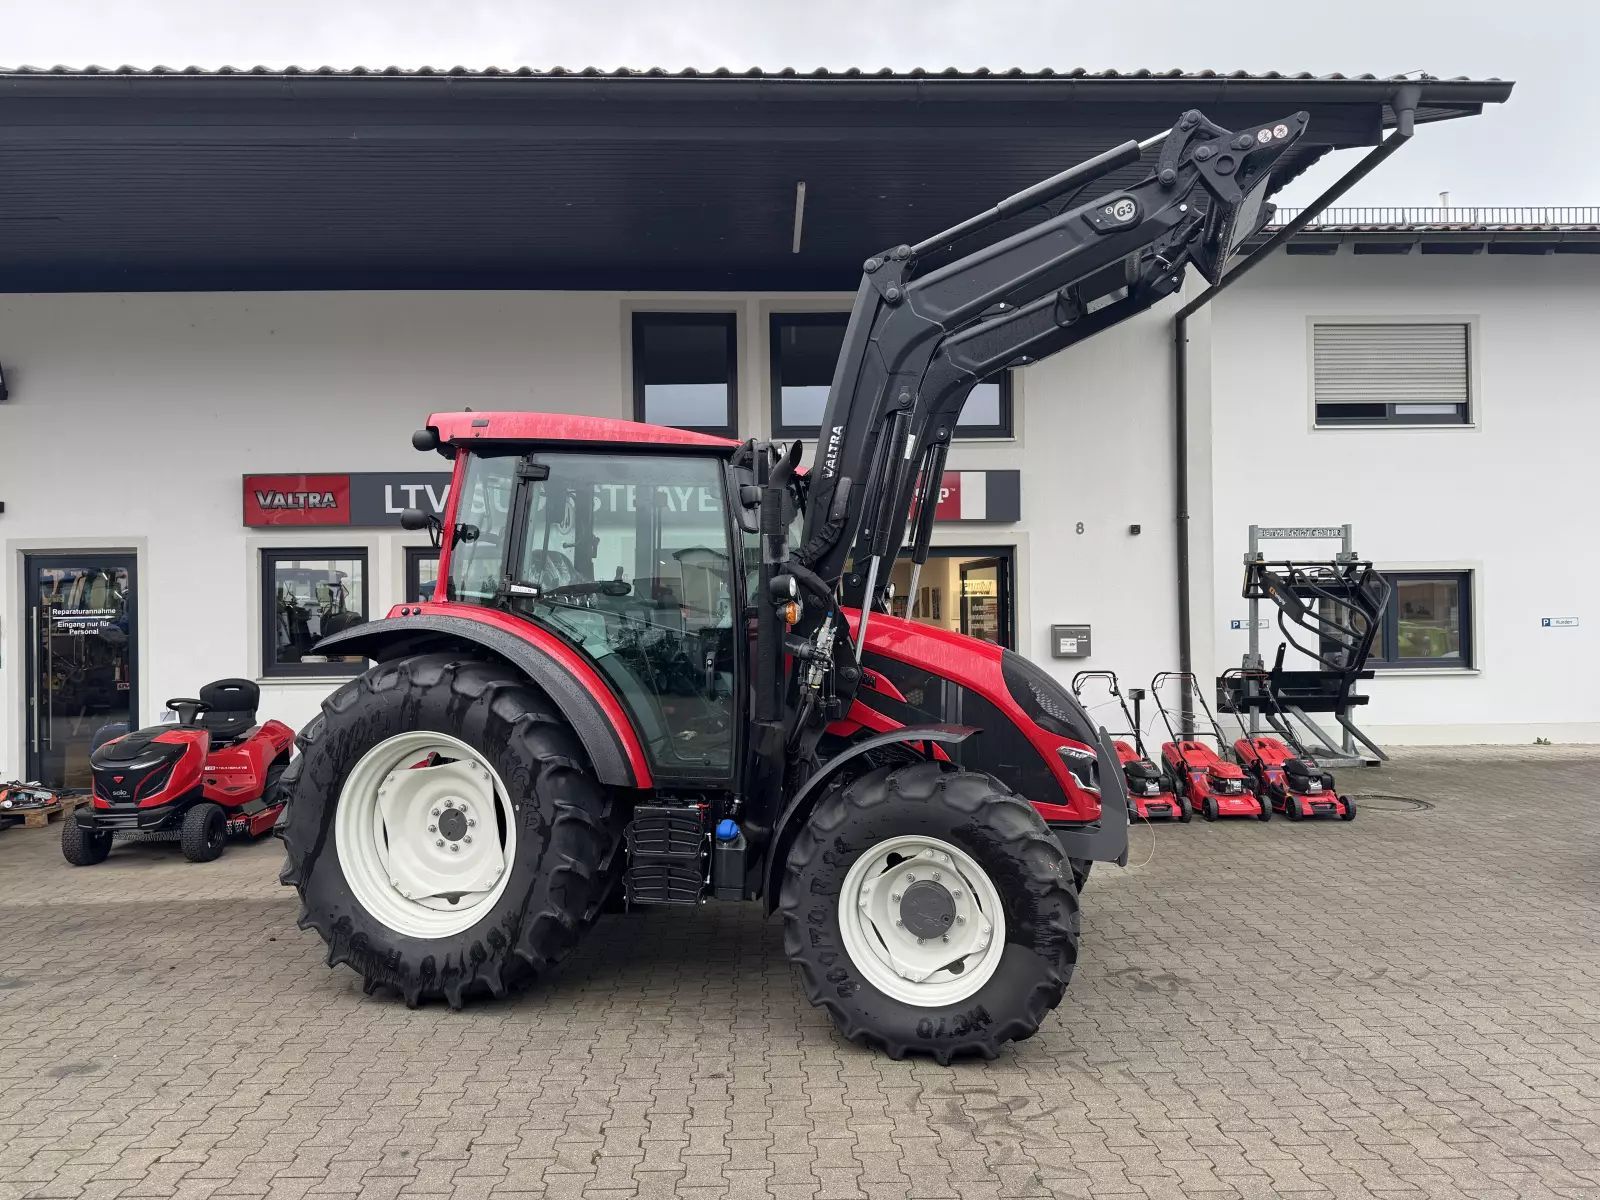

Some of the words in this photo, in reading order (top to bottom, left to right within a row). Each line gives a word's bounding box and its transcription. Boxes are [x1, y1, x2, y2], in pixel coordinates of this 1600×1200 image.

[1116, 202, 1132, 217] G3
[821, 425, 843, 479] VALTRA
[254, 490, 338, 509] VALTRA
[384, 484, 451, 514] LTV
[1075, 521, 1085, 535] 8
[52, 608, 116, 616] Reparaturannahme
